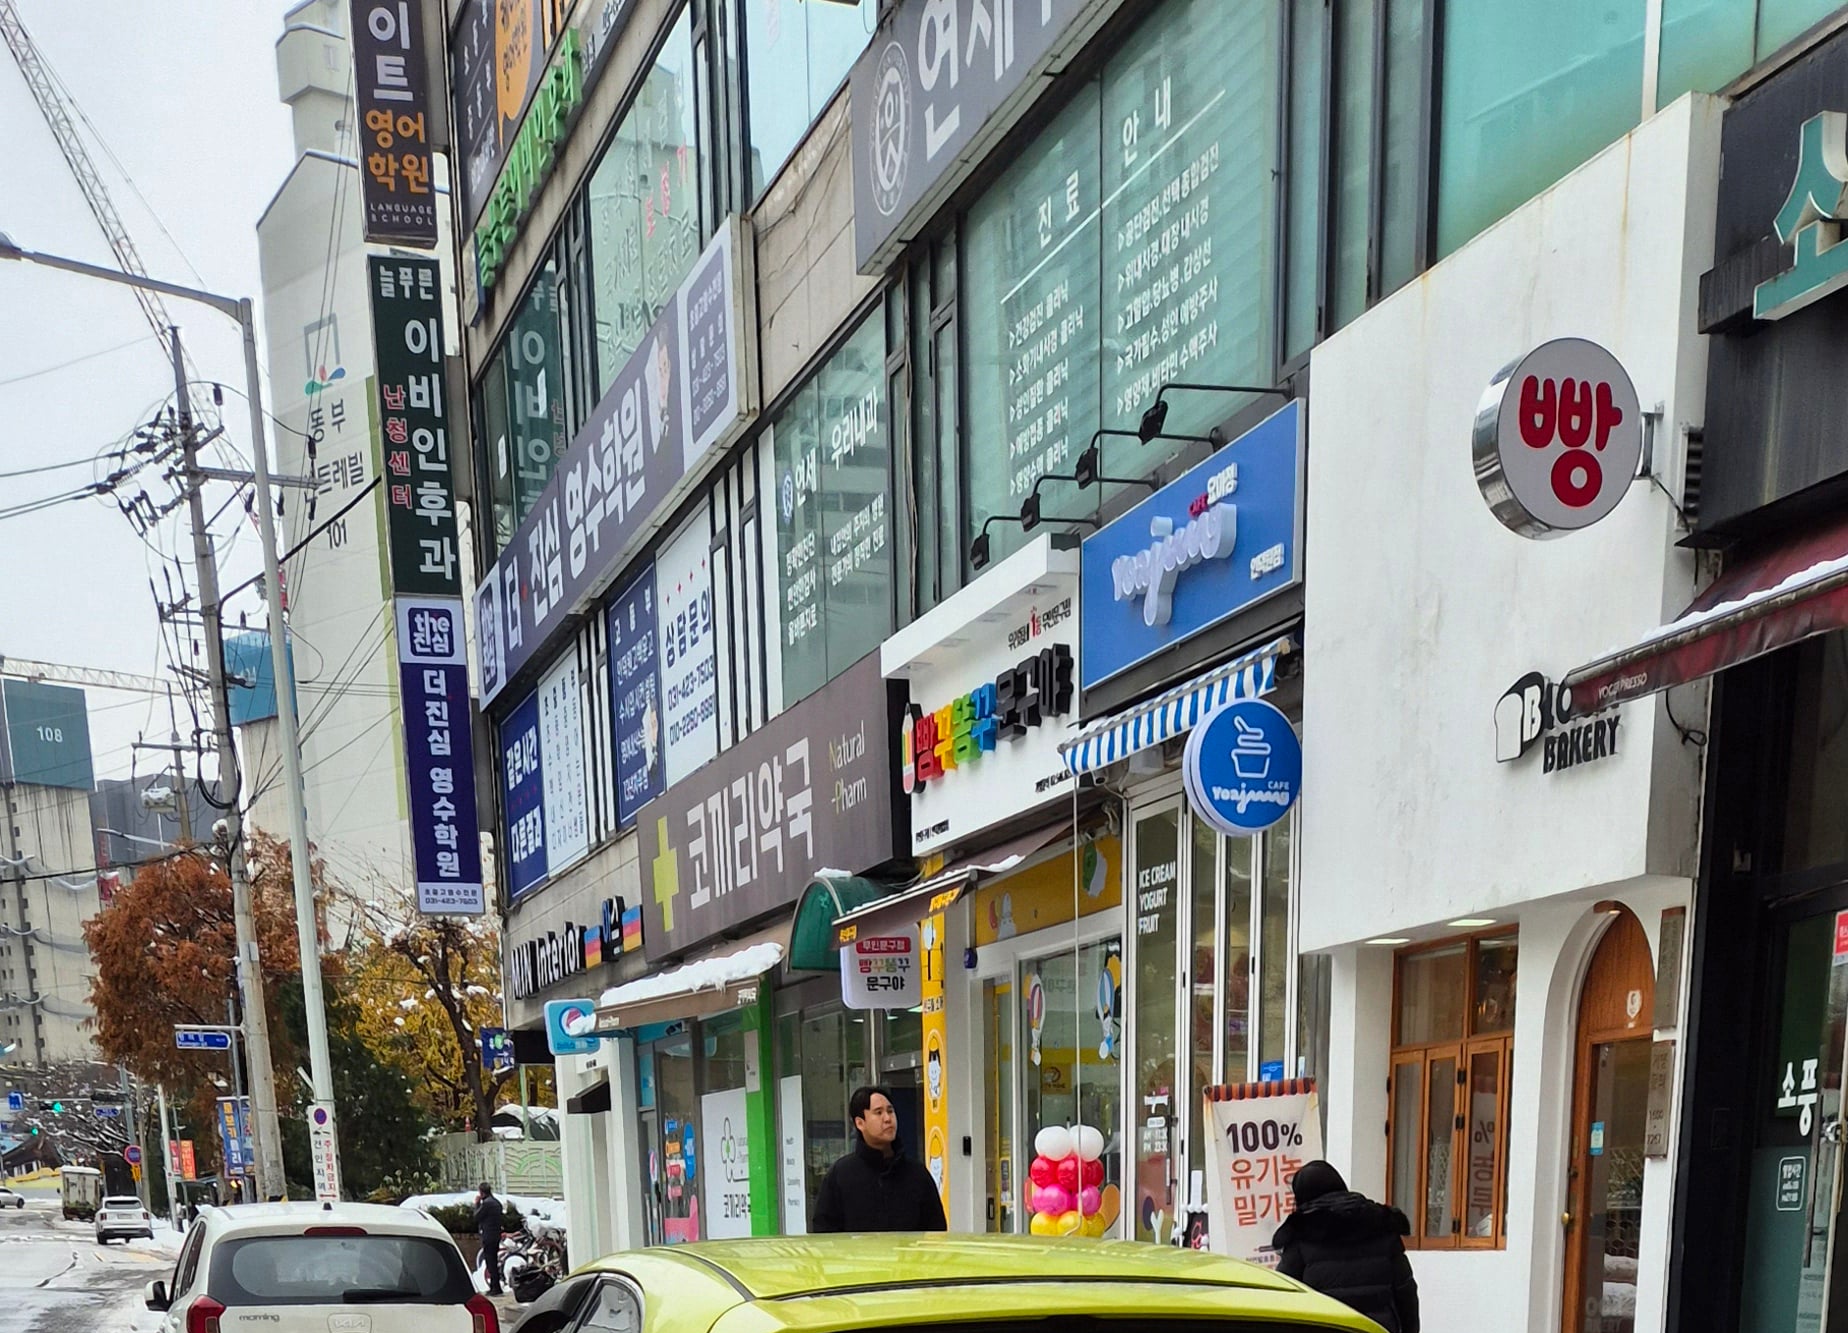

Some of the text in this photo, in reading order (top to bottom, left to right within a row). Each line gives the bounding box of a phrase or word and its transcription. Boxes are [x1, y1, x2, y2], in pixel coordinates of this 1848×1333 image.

[366, 109, 425, 148] 영어
[368, 153, 429, 194] 학원
[370, 203, 433, 215] LANGUAGE
[371, 216, 434, 226] SCHOOL
[380, 265, 434, 300] 늘푸른
[1046, 278, 1068, 320] 클리닉
[1060, 303, 1083, 346] 클리닉
[1046, 356, 1068, 396] 클리닉
[1046, 394, 1068, 435] 클리닉
[383, 384, 413, 509] 난청센터
[404, 317, 457, 580] 이비인후과
[795, 386, 877, 508] 연세 우리내과
[1046, 434, 1068, 473] 클리닉
[1518, 374, 1623, 508] 빵
[565, 377, 646, 581] 영수학원
[326, 519, 348, 550] 101
[413, 634, 449, 654] 진심
[414, 611, 450, 645] the
[666, 586, 712, 668] 상담문의
[915, 643, 1073, 780] 빵꾸똥꾸 문구야
[37, 726, 63, 742] 108
[829, 720, 866, 773] Natural
[1543, 715, 1621, 774] BAKERY
[1267, 780, 1290, 790] CAFE
[430, 767, 461, 878] 영수학원
[687, 737, 813, 910] 코끼리약국
[1139, 860, 1176, 889] ICE CREAM
[1139, 887, 1168, 913] YOGURT
[1138, 913, 1161, 936] FRUIT
[859, 957, 910, 973] 빵꾸똥꾸
[863, 940, 905, 951] 무인문구점
[866, 976, 905, 992] 문구야
[1777, 1058, 1818, 1137] 소풍
[1226, 1119, 1303, 1154] 100%
[1230, 1154, 1302, 1190] 유기농
